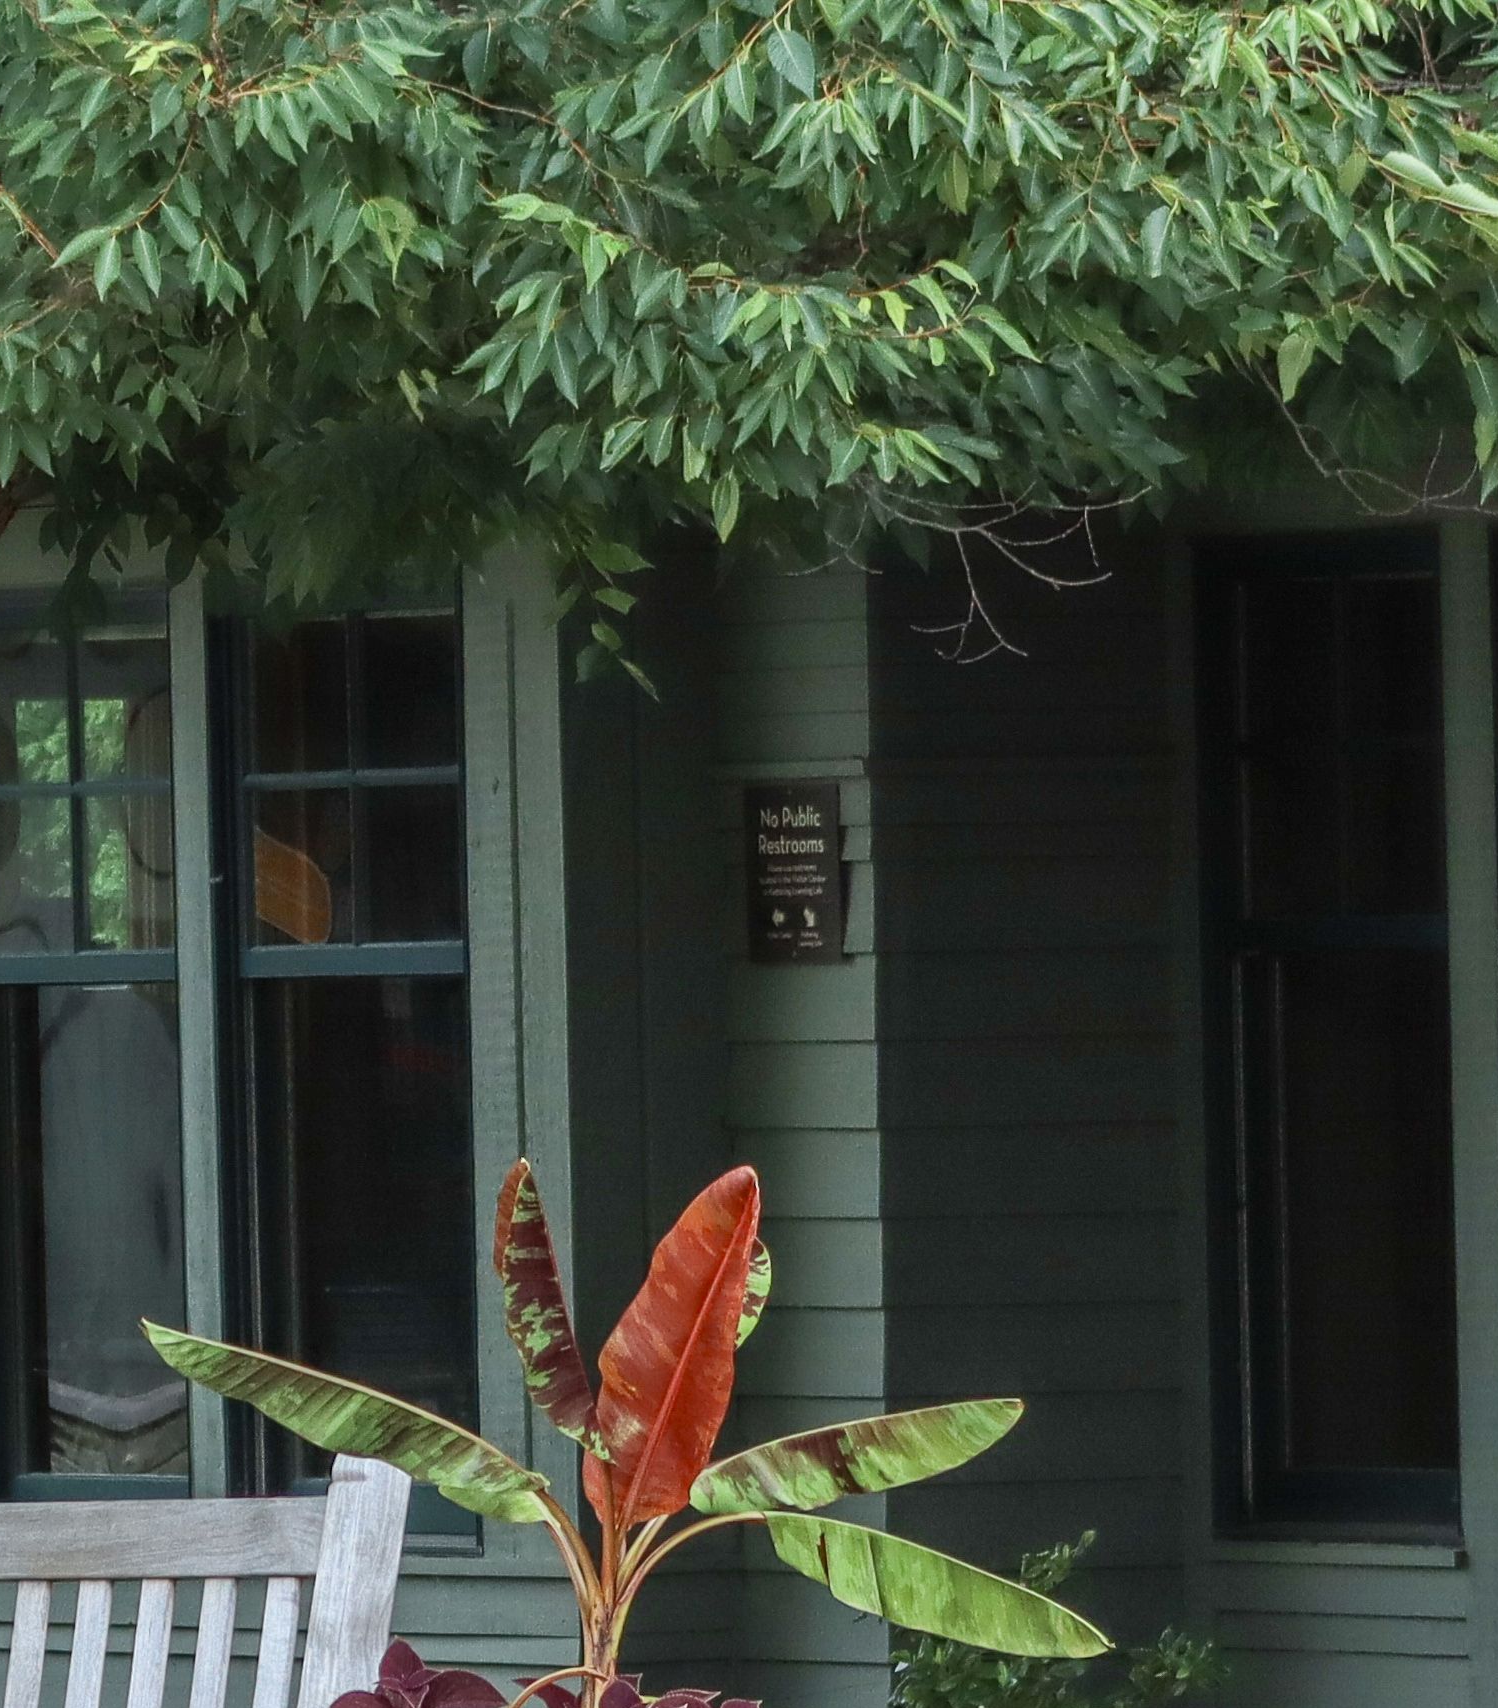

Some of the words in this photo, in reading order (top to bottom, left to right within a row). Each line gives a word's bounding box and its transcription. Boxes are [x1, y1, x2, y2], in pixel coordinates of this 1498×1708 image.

[759, 808, 779, 828] No
[782, 805, 821, 828] Public
[758, 834, 824, 855] Restrooms
